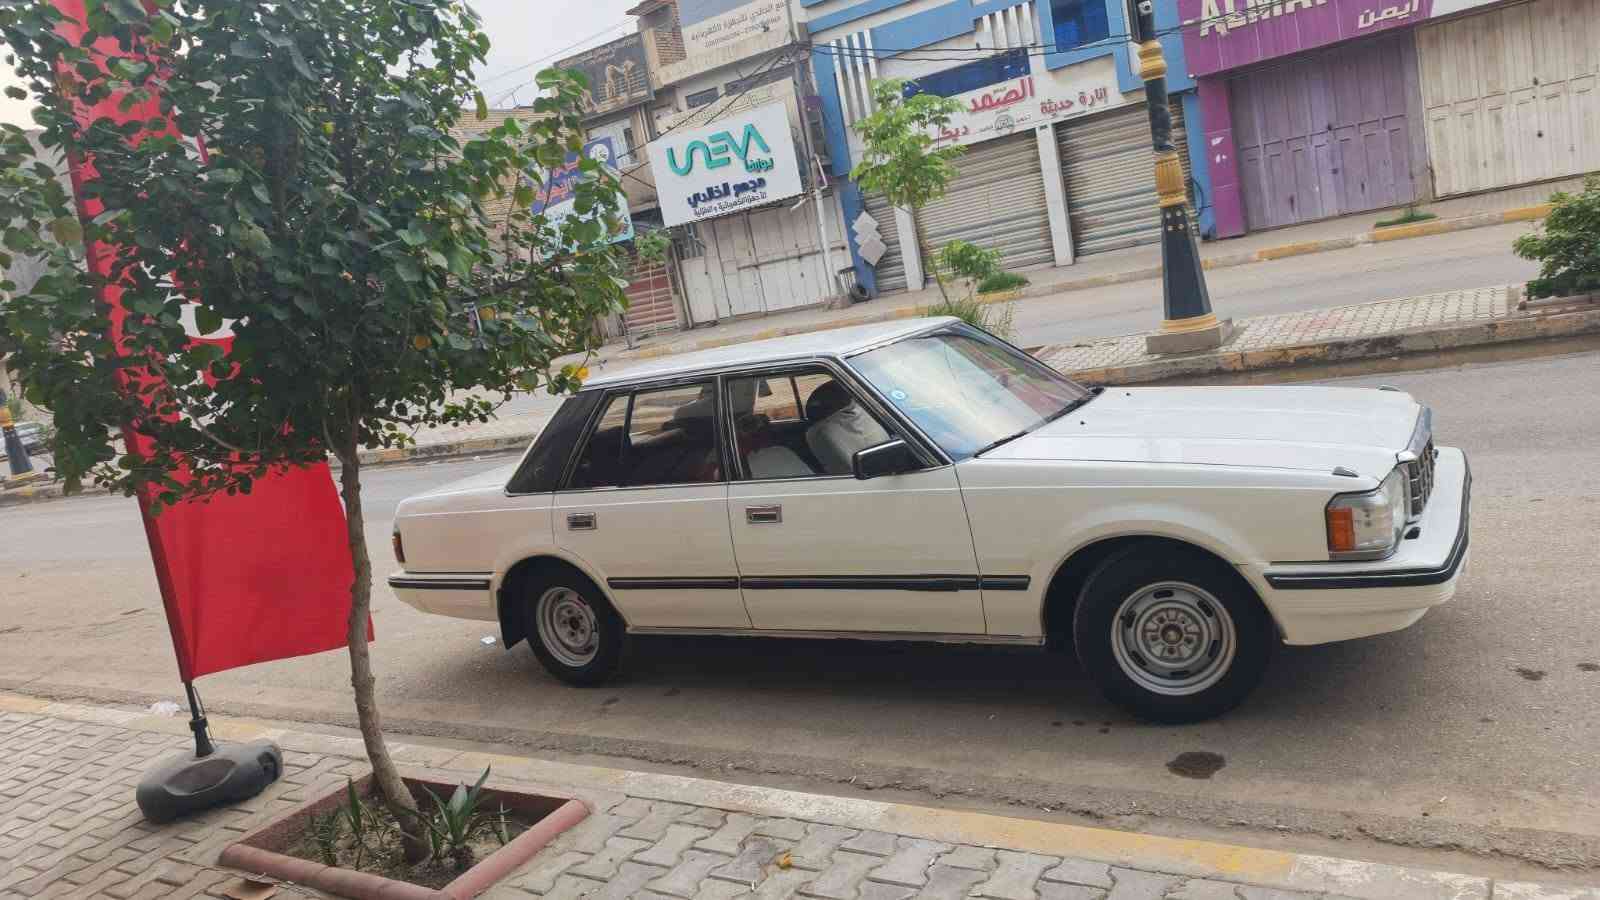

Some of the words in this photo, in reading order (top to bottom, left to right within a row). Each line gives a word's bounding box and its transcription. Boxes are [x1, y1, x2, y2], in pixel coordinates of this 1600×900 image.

[970, 76, 1036, 113] الصمد
[1040, 98, 1074, 118] حديثة
[687, 183, 730, 208] الخالدي
[734, 177, 767, 197] مجمع
